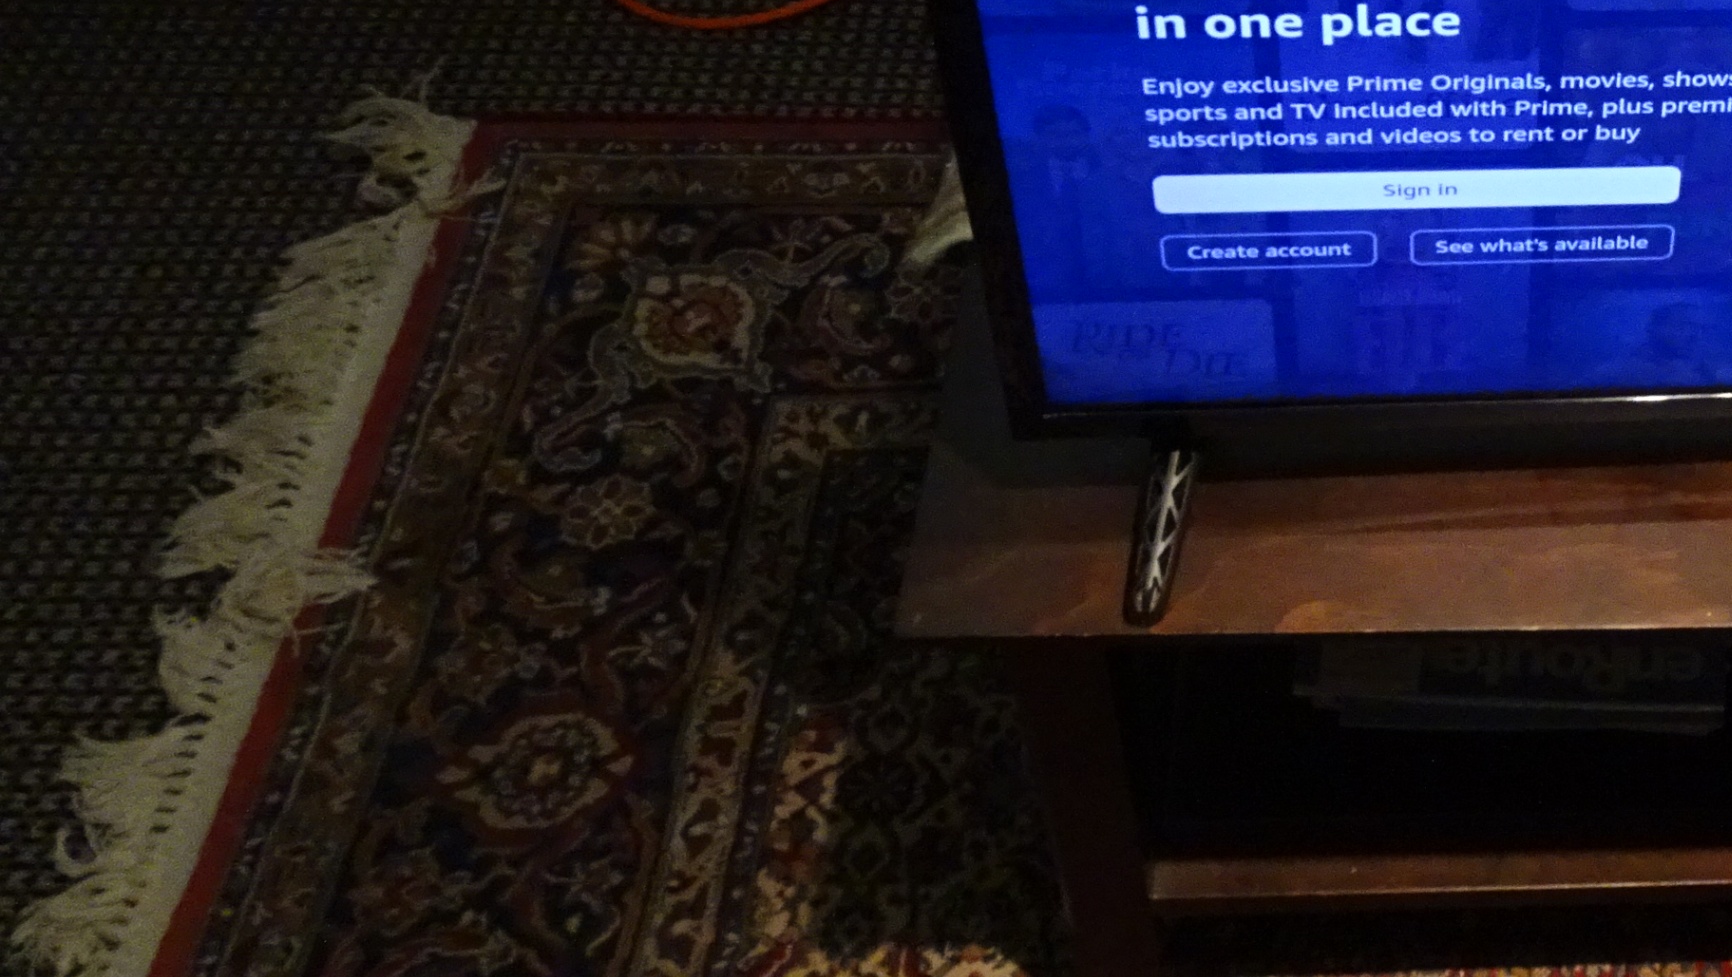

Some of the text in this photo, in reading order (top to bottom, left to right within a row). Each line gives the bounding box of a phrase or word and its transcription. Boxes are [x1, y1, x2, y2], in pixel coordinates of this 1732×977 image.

[1135, 3, 1460, 45] in one place
[1142, 77, 1214, 98] Enjoy
[1222, 75, 1339, 93] exclusive
[1347, 75, 1422, 91] Prime
[1431, 72, 1552, 94] Originals,
[1560, 72, 1654, 90] movies,
[1145, 105, 1227, 125] sports
[1235, 103, 1282, 120] and
[1290, 103, 1326, 119] TV
[1334, 101, 1443, 118] included
[1450, 100, 1506, 117] with
[1515, 99, 1593, 118] Prime,
[1602, 98, 1654, 118] plus
[1148, 124, 1641, 150] subscriptions and videos to rent or buy
[1383, 183, 1458, 200] Sign in
[1187, 243, 1352, 259] Create account
[1435, 235, 1648, 254] See what's available
